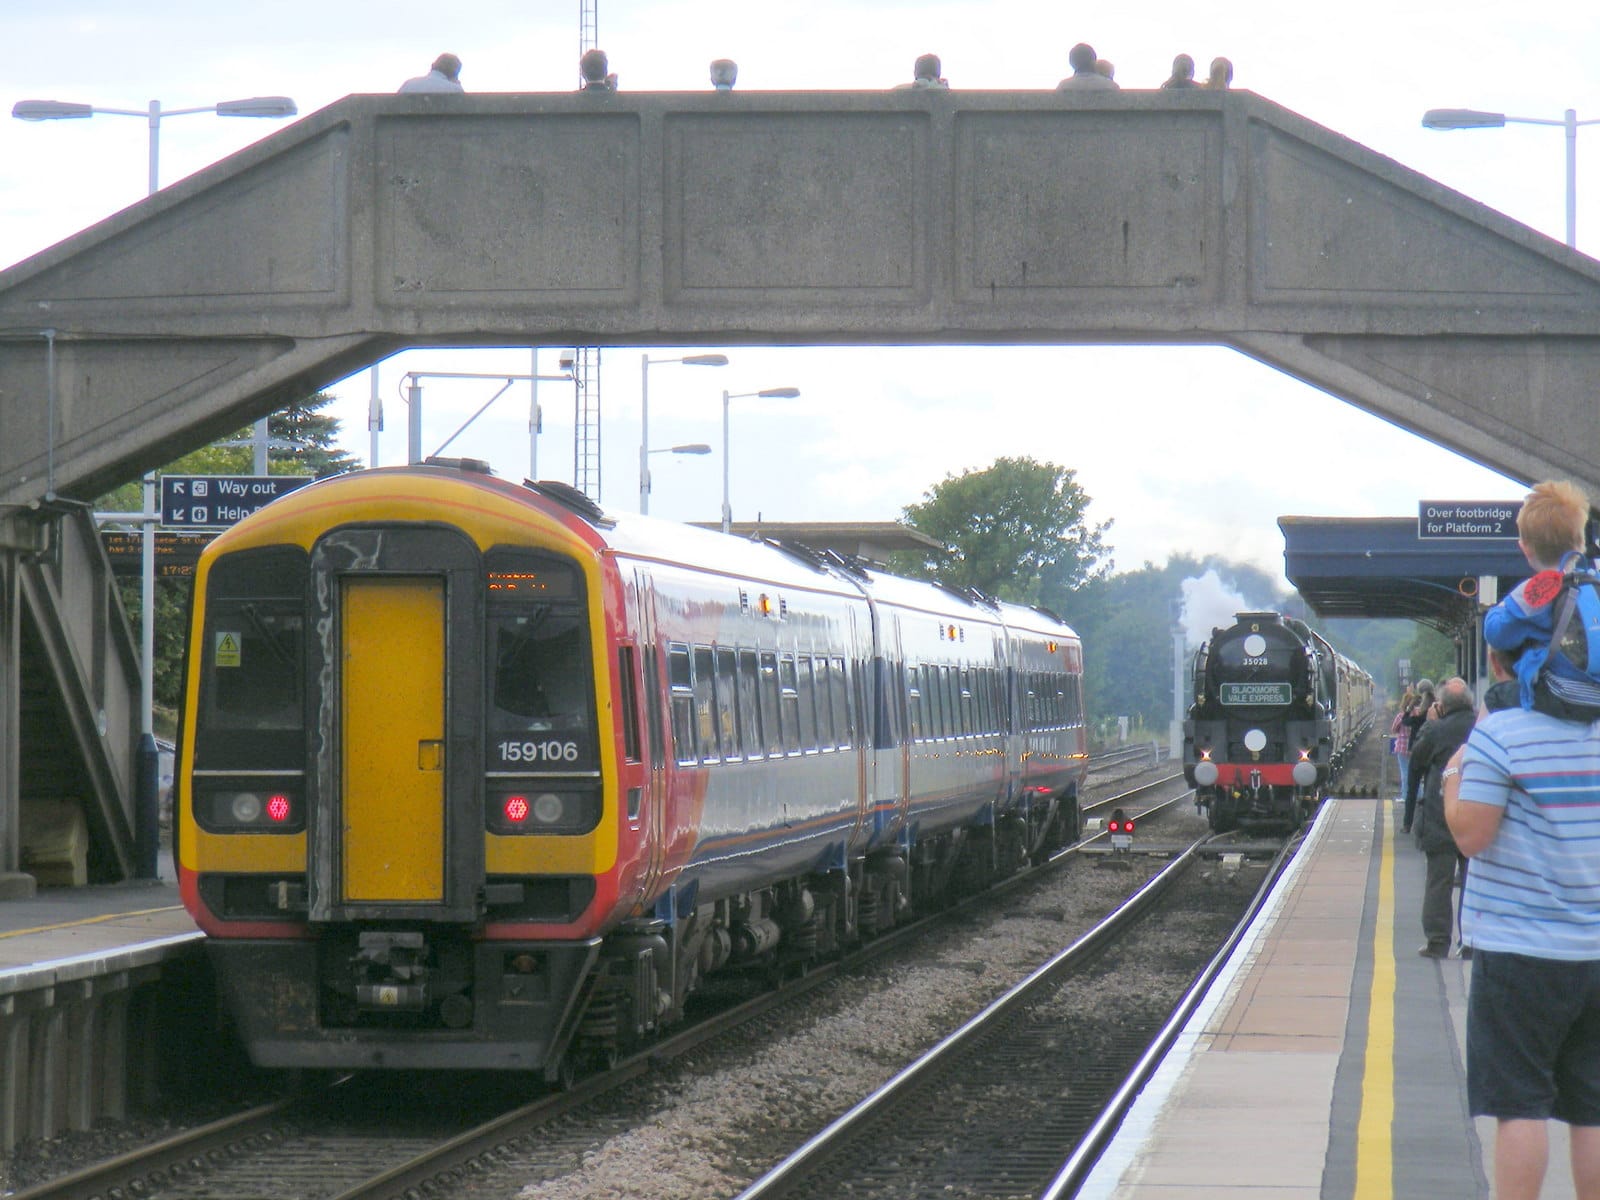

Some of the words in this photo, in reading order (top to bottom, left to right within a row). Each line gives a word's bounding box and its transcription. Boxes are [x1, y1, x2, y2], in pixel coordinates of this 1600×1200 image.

[218, 480, 248, 497] Way
[252, 482, 277, 494] out
[217, 506, 250, 520] Help
[1427, 507, 1453, 518] Over
[1455, 507, 1512, 520] footbridge
[1427, 522, 1442, 533] for
[1446, 522, 1492, 533] Platform
[1494, 522, 1502, 533] 2
[1243, 658, 1268, 666] 35028
[1231, 686, 1280, 694] BLACKMORE
[1228, 694, 1247, 702] VALE
[1249, 694, 1285, 702] EXPRESS
[498, 741, 578, 761] 159106
